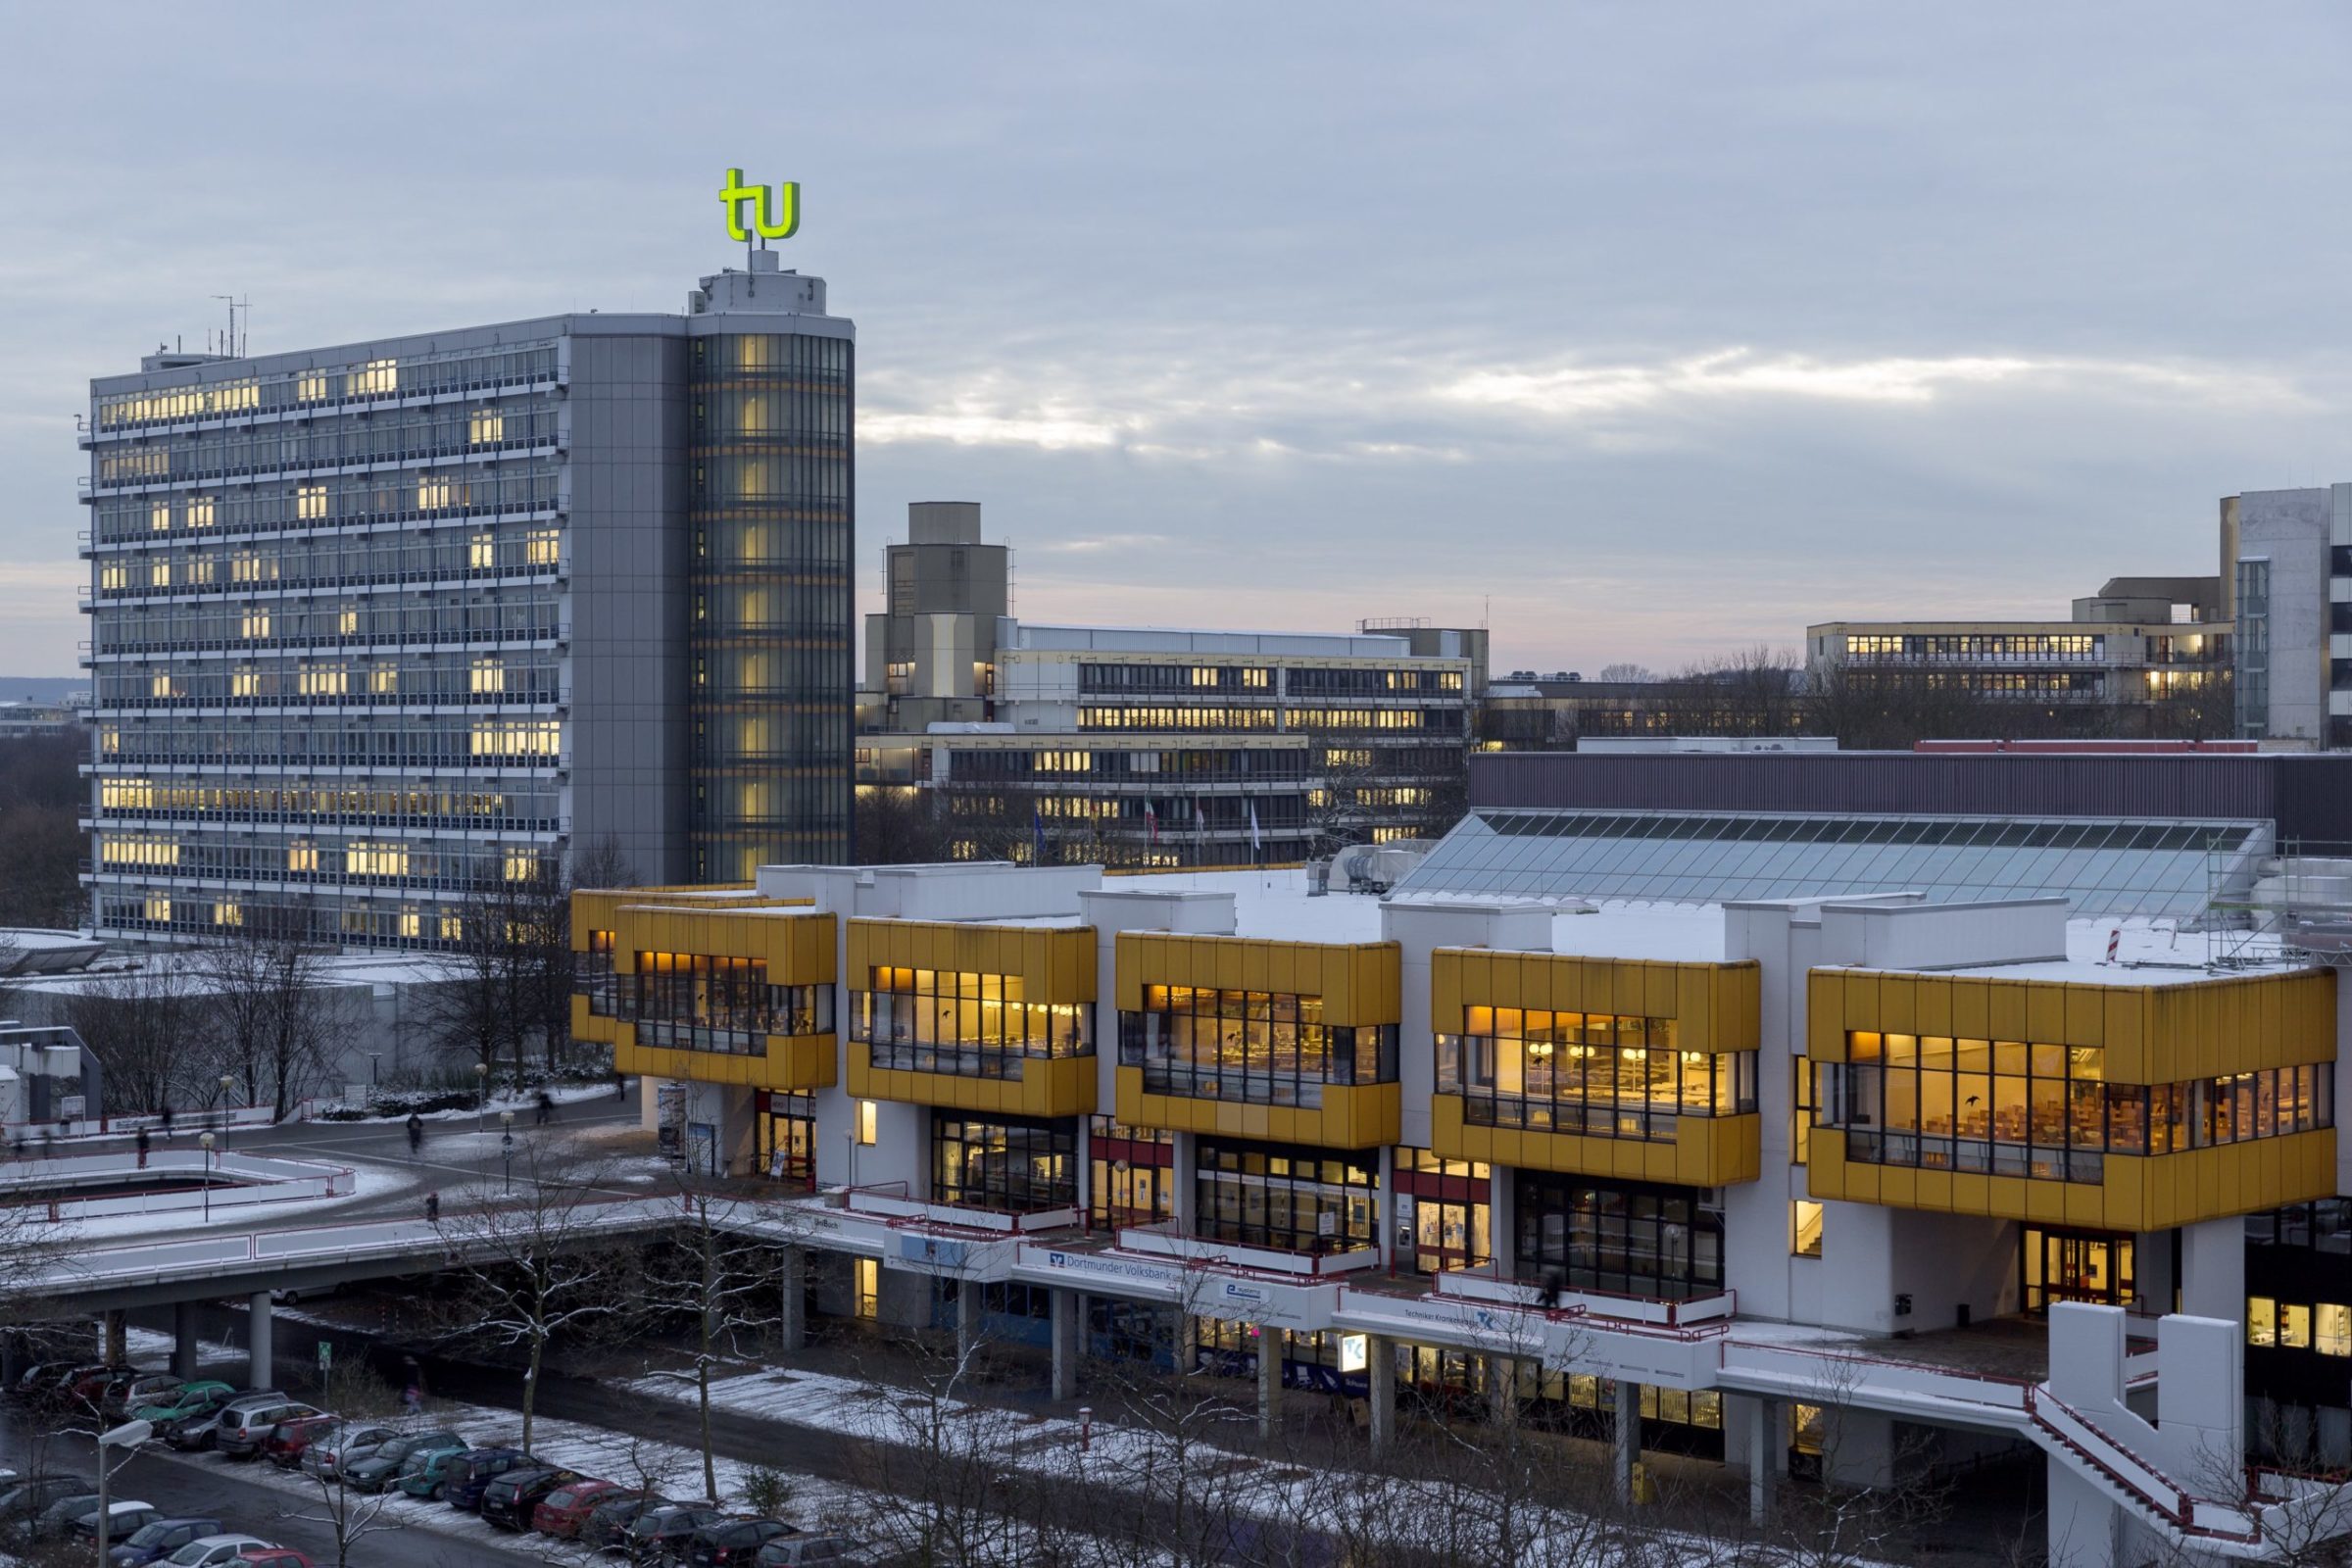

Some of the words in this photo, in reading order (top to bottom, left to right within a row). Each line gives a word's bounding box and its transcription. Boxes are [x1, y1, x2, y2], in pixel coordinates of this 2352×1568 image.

[719, 168, 800, 242] tu
[1067, 1255, 1123, 1274] Dortmunder
[1124, 1264, 1172, 1280] Volksbank
[1405, 1309, 1435, 1320] Techniker
[1345, 1338, 1363, 1359] TK
